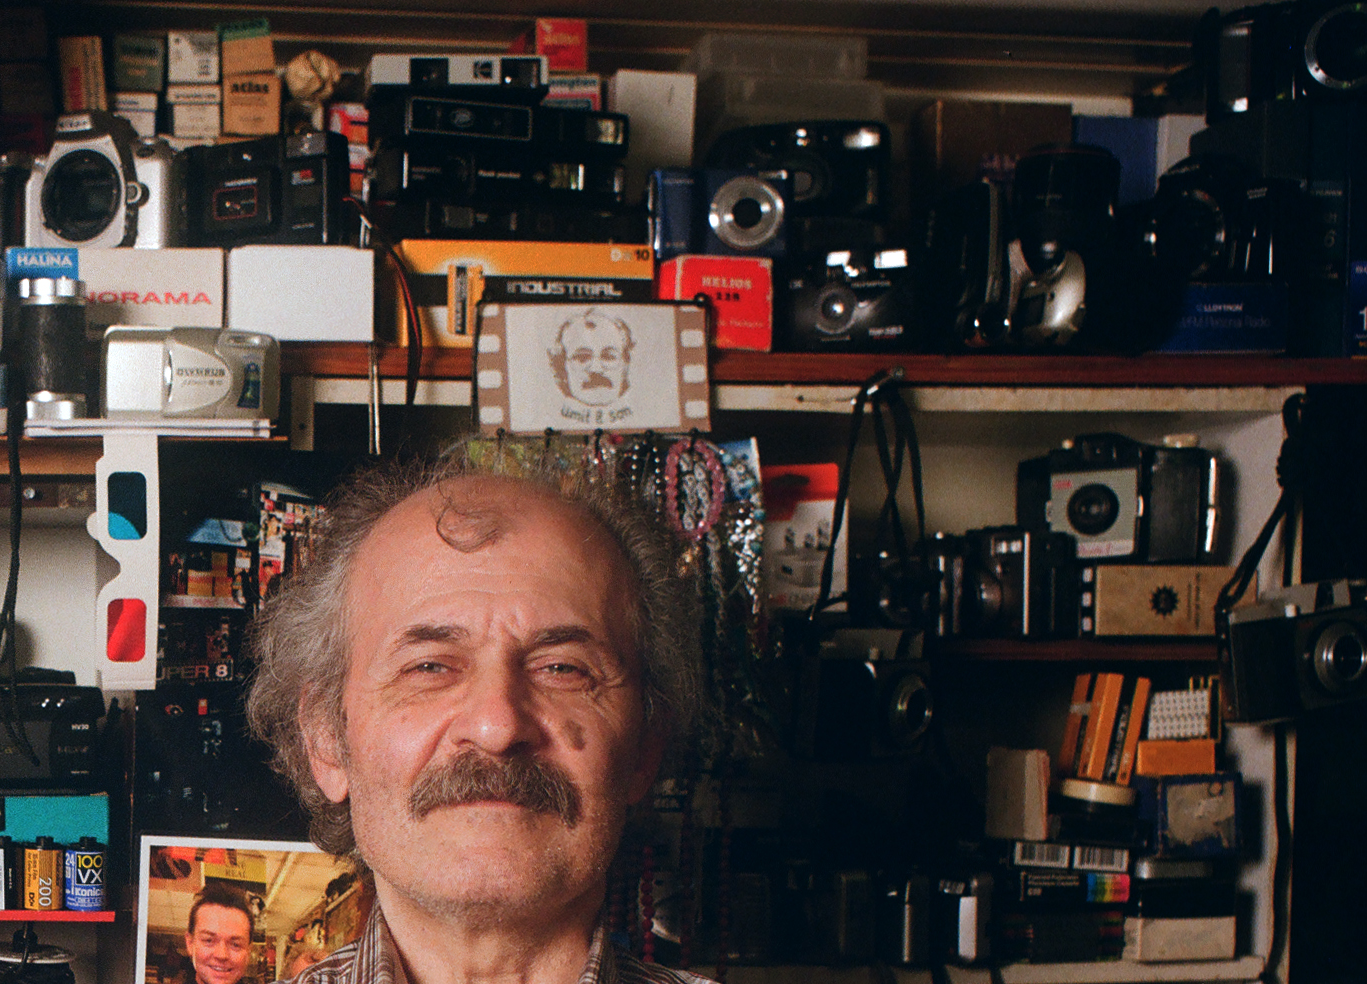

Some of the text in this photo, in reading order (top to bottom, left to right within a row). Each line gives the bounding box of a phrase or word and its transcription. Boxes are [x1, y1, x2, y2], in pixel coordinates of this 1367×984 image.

[231, 81, 270, 94] atlas
[17, 255, 72, 267] HALINA
[702, 277, 753, 290] HELIOS
[176, 367, 226, 377] OLYMPUS
[608, 406, 633, 421] son
[215, 664, 229, 678] 8
[66, 853, 75, 866] 24
[77, 854, 103, 868] 100
[77, 869, 103, 884] VX
[38, 877, 52, 906] 200
